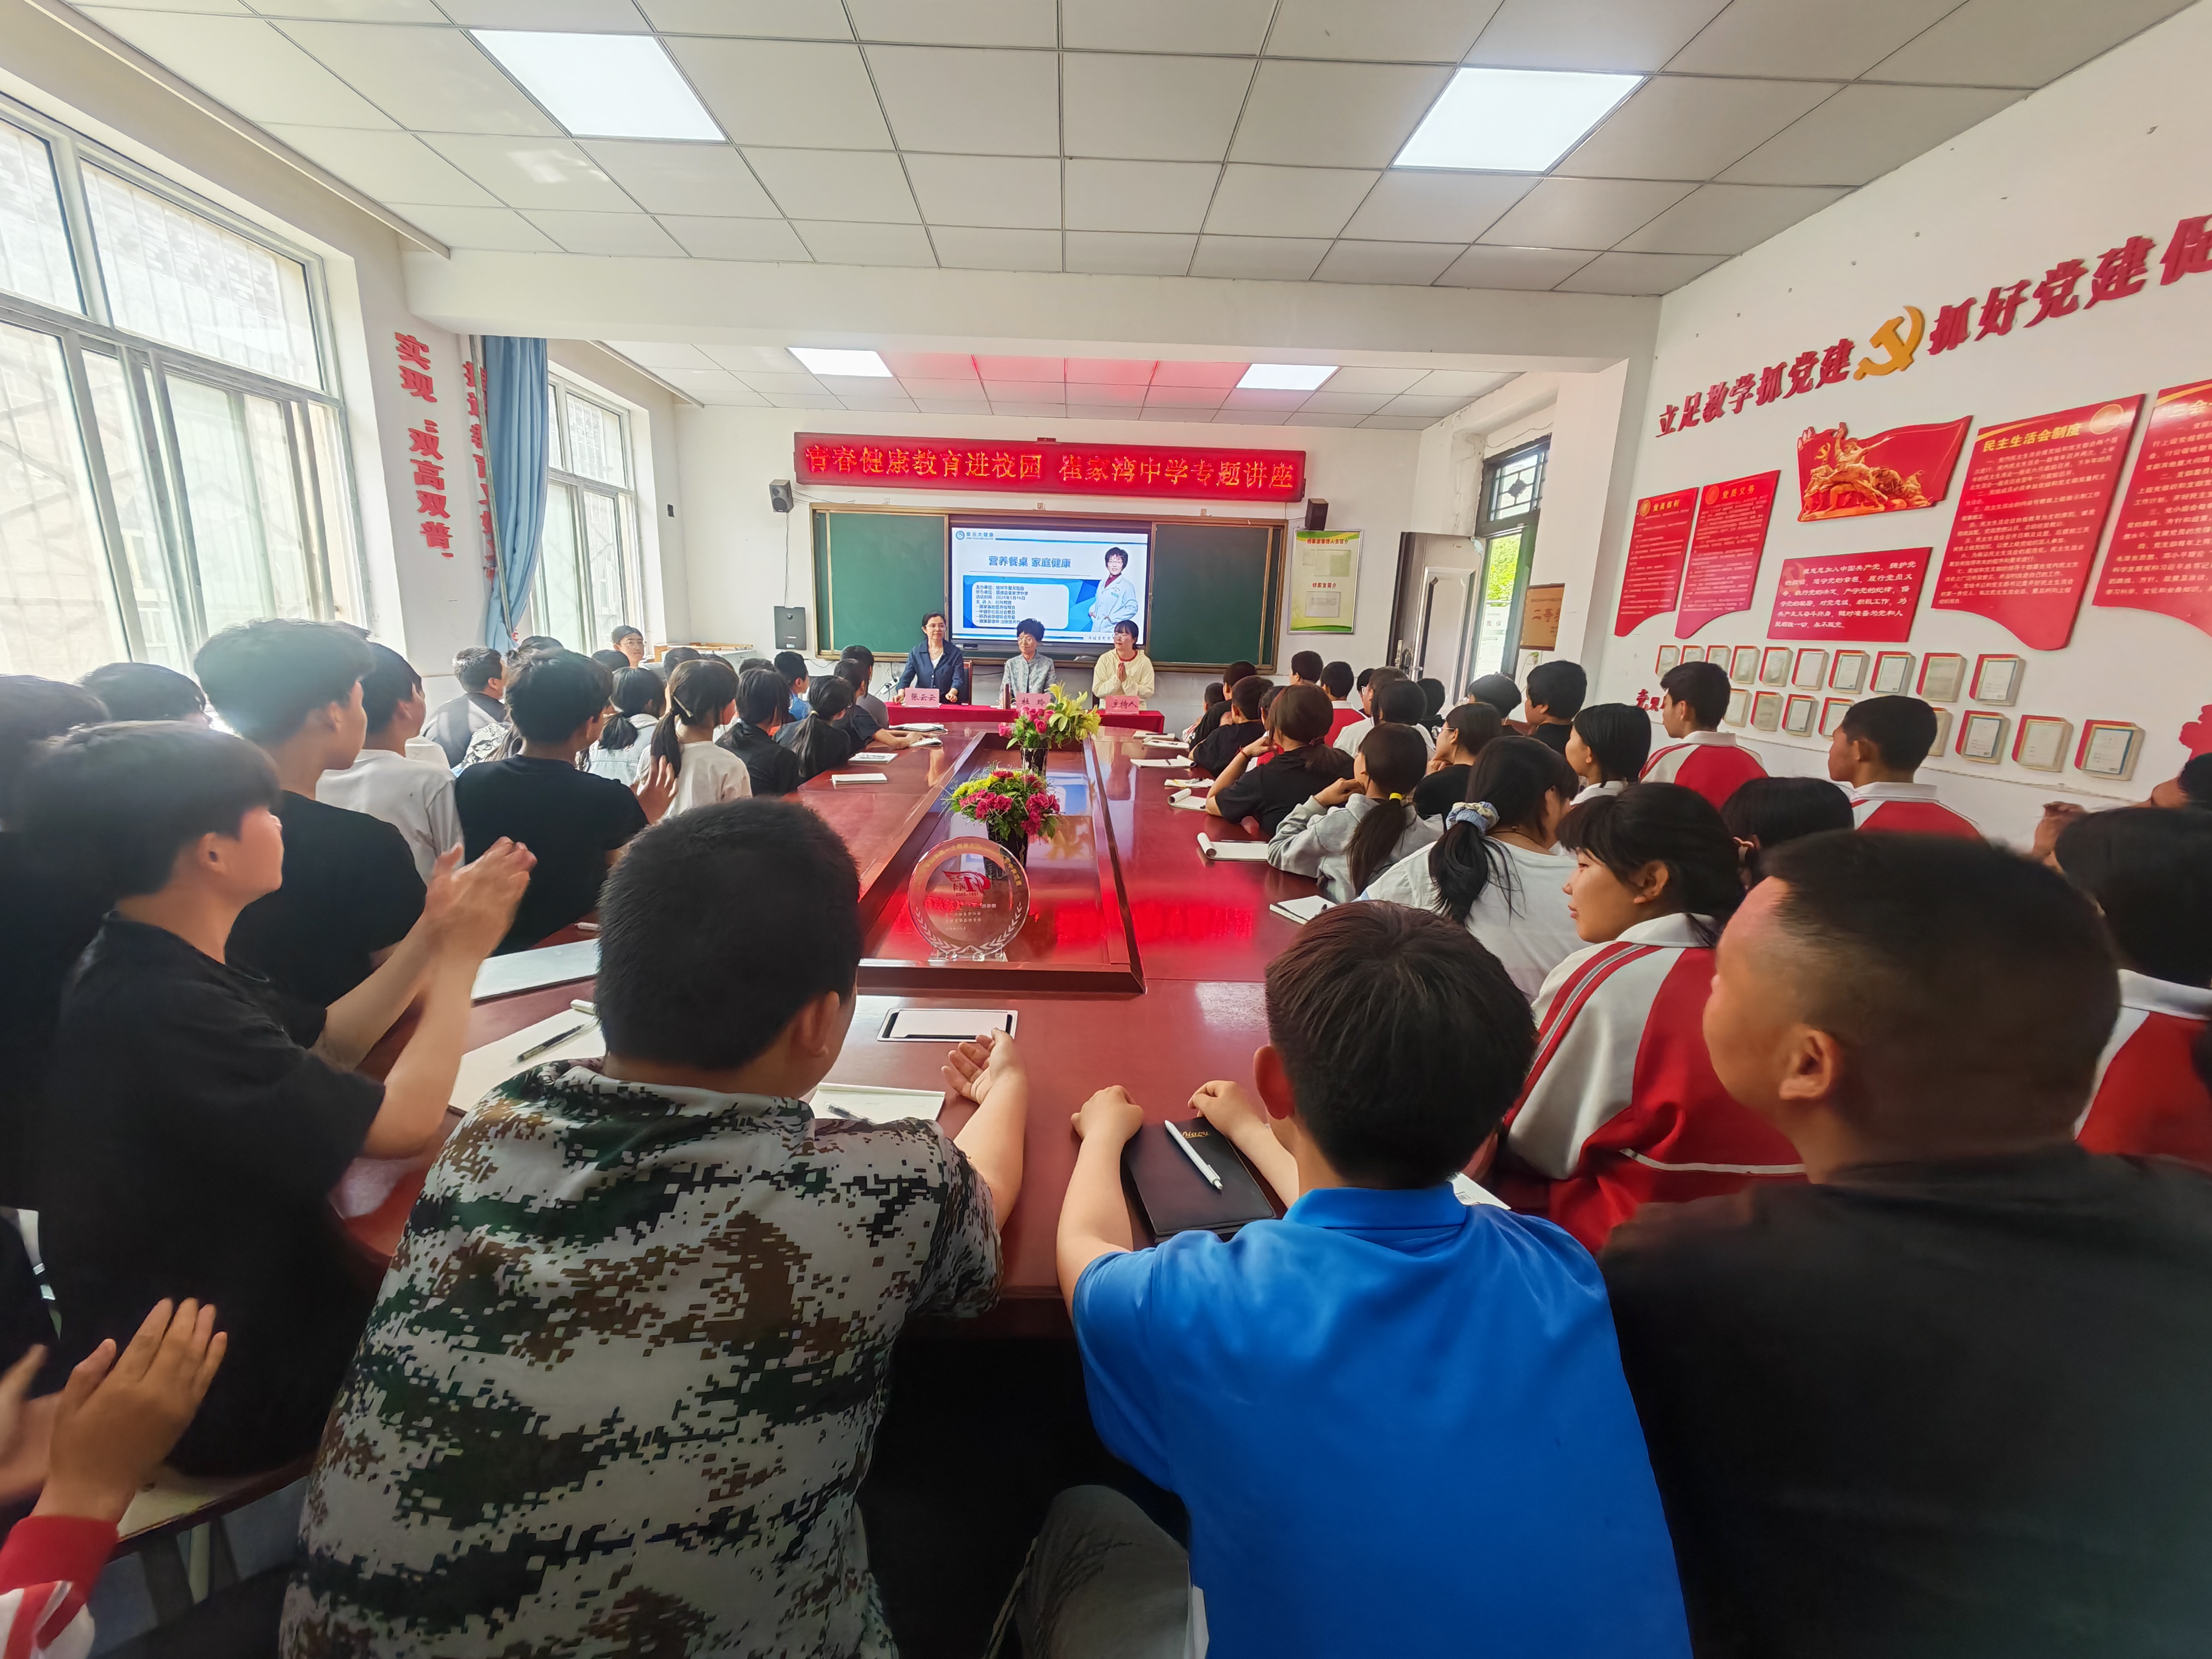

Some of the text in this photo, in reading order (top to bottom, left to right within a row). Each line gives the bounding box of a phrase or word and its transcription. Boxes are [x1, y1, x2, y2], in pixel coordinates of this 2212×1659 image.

[1655, 338, 1855, 437] 立足教学抓党建
[2168, 399, 2212, 418] 三会
[1983, 422, 2083, 452] 民主生活会制度
[805, 445, 1294, 489] 青春健康教育进校园 崔家湾中学专题讲座
[989, 556, 1071, 568] 营养餐桌 家庭健康
[911, 692, 936, 701] 张云云
[1111, 699, 1138, 709] 主持人
